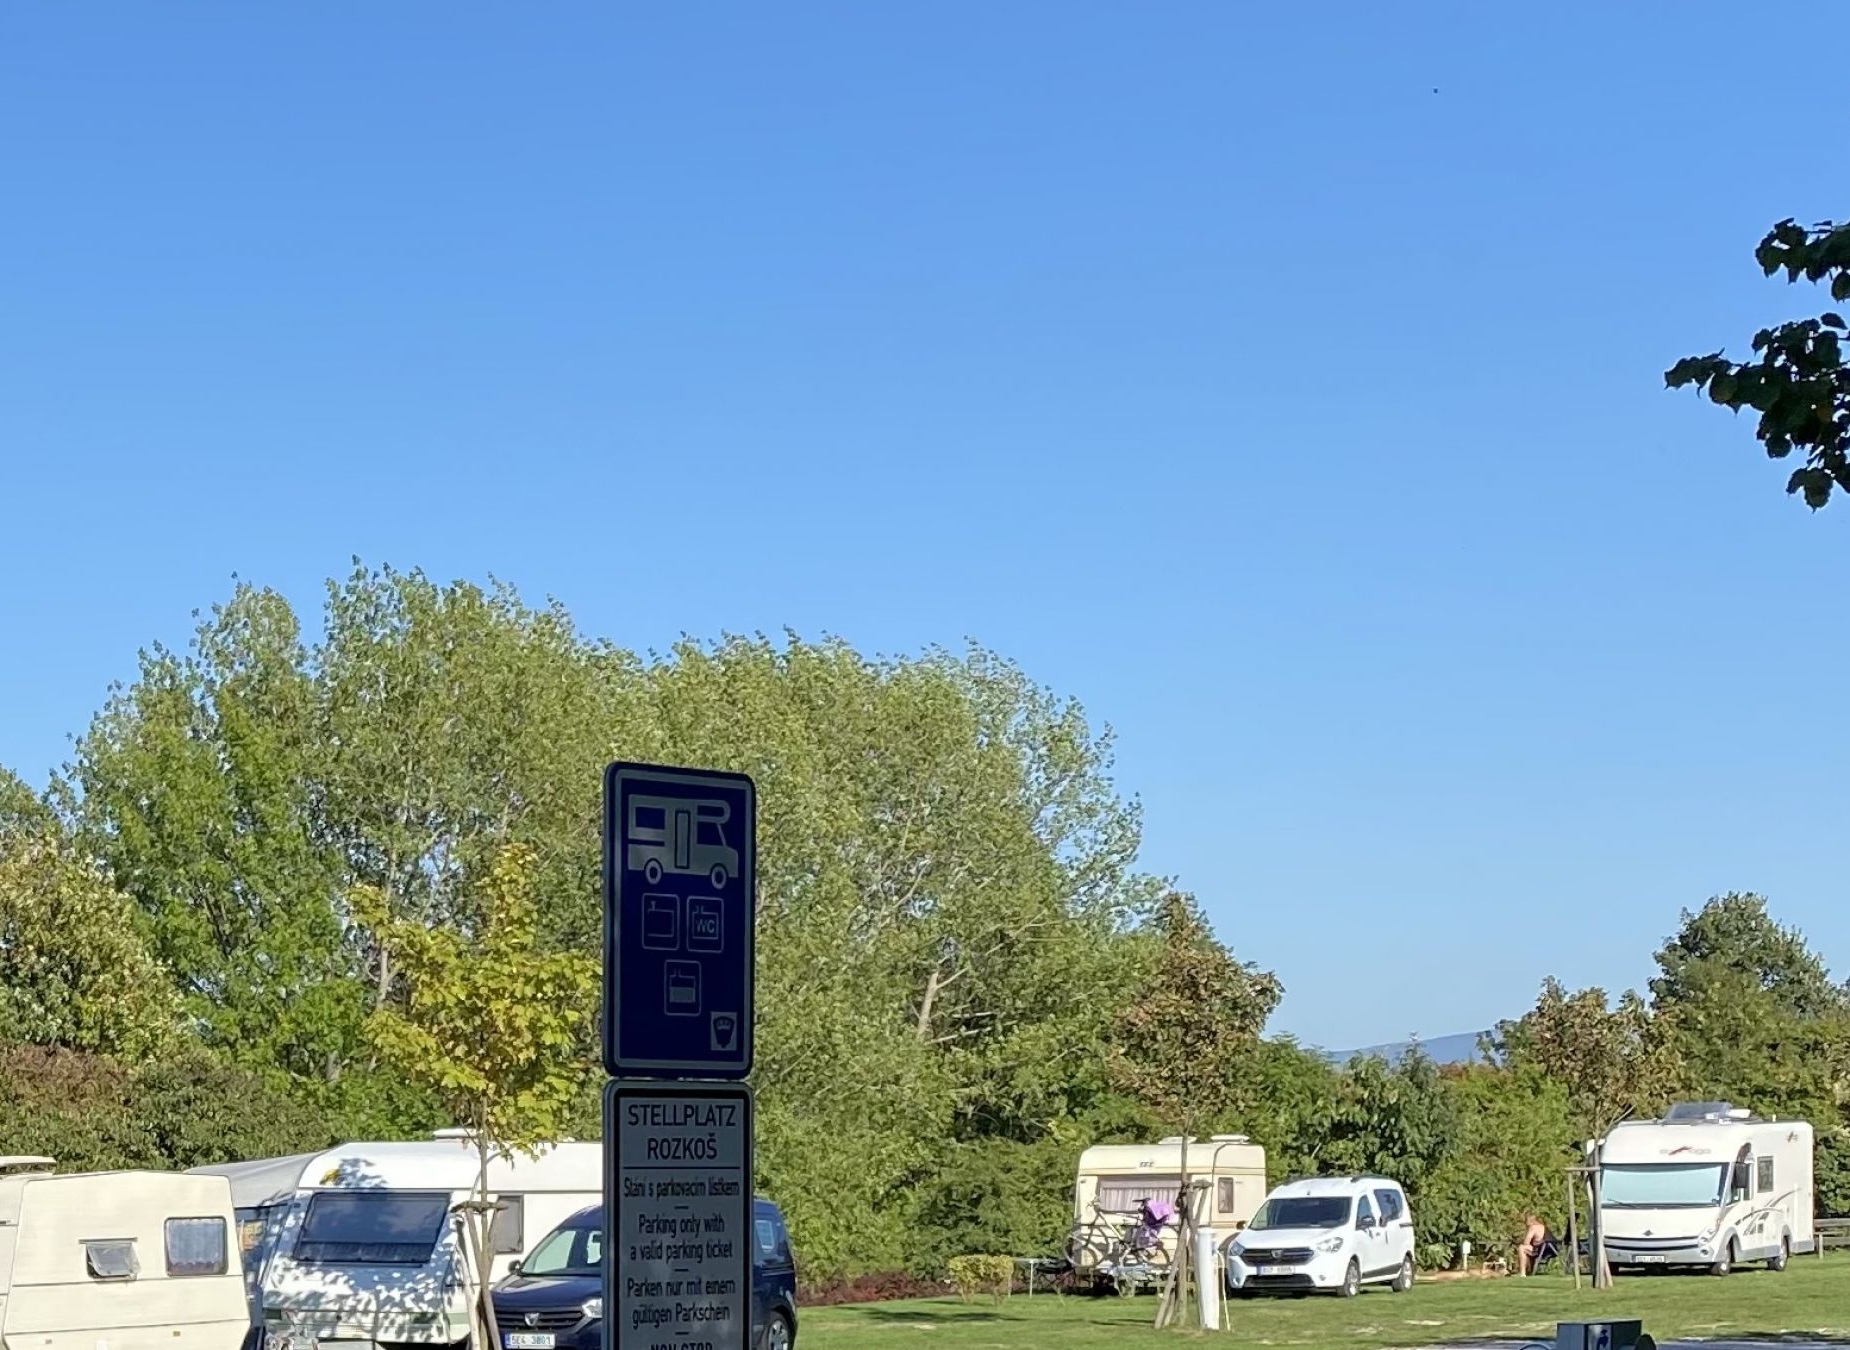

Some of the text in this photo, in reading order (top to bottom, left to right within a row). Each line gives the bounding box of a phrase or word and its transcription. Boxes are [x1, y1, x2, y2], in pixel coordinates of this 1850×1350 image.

[695, 918, 716, 933] WC
[628, 1103, 737, 1127] STELLPLATZ
[647, 1132, 718, 1160] ROZKOŠ
[648, 1181, 655, 1197] s
[638, 1212, 726, 1238] Parking only with
[630, 1239, 733, 1264] a valid parking ticket
[627, 1276, 736, 1298] Parken nur mit einem
[632, 1302, 731, 1330] gültigen Parkschein
